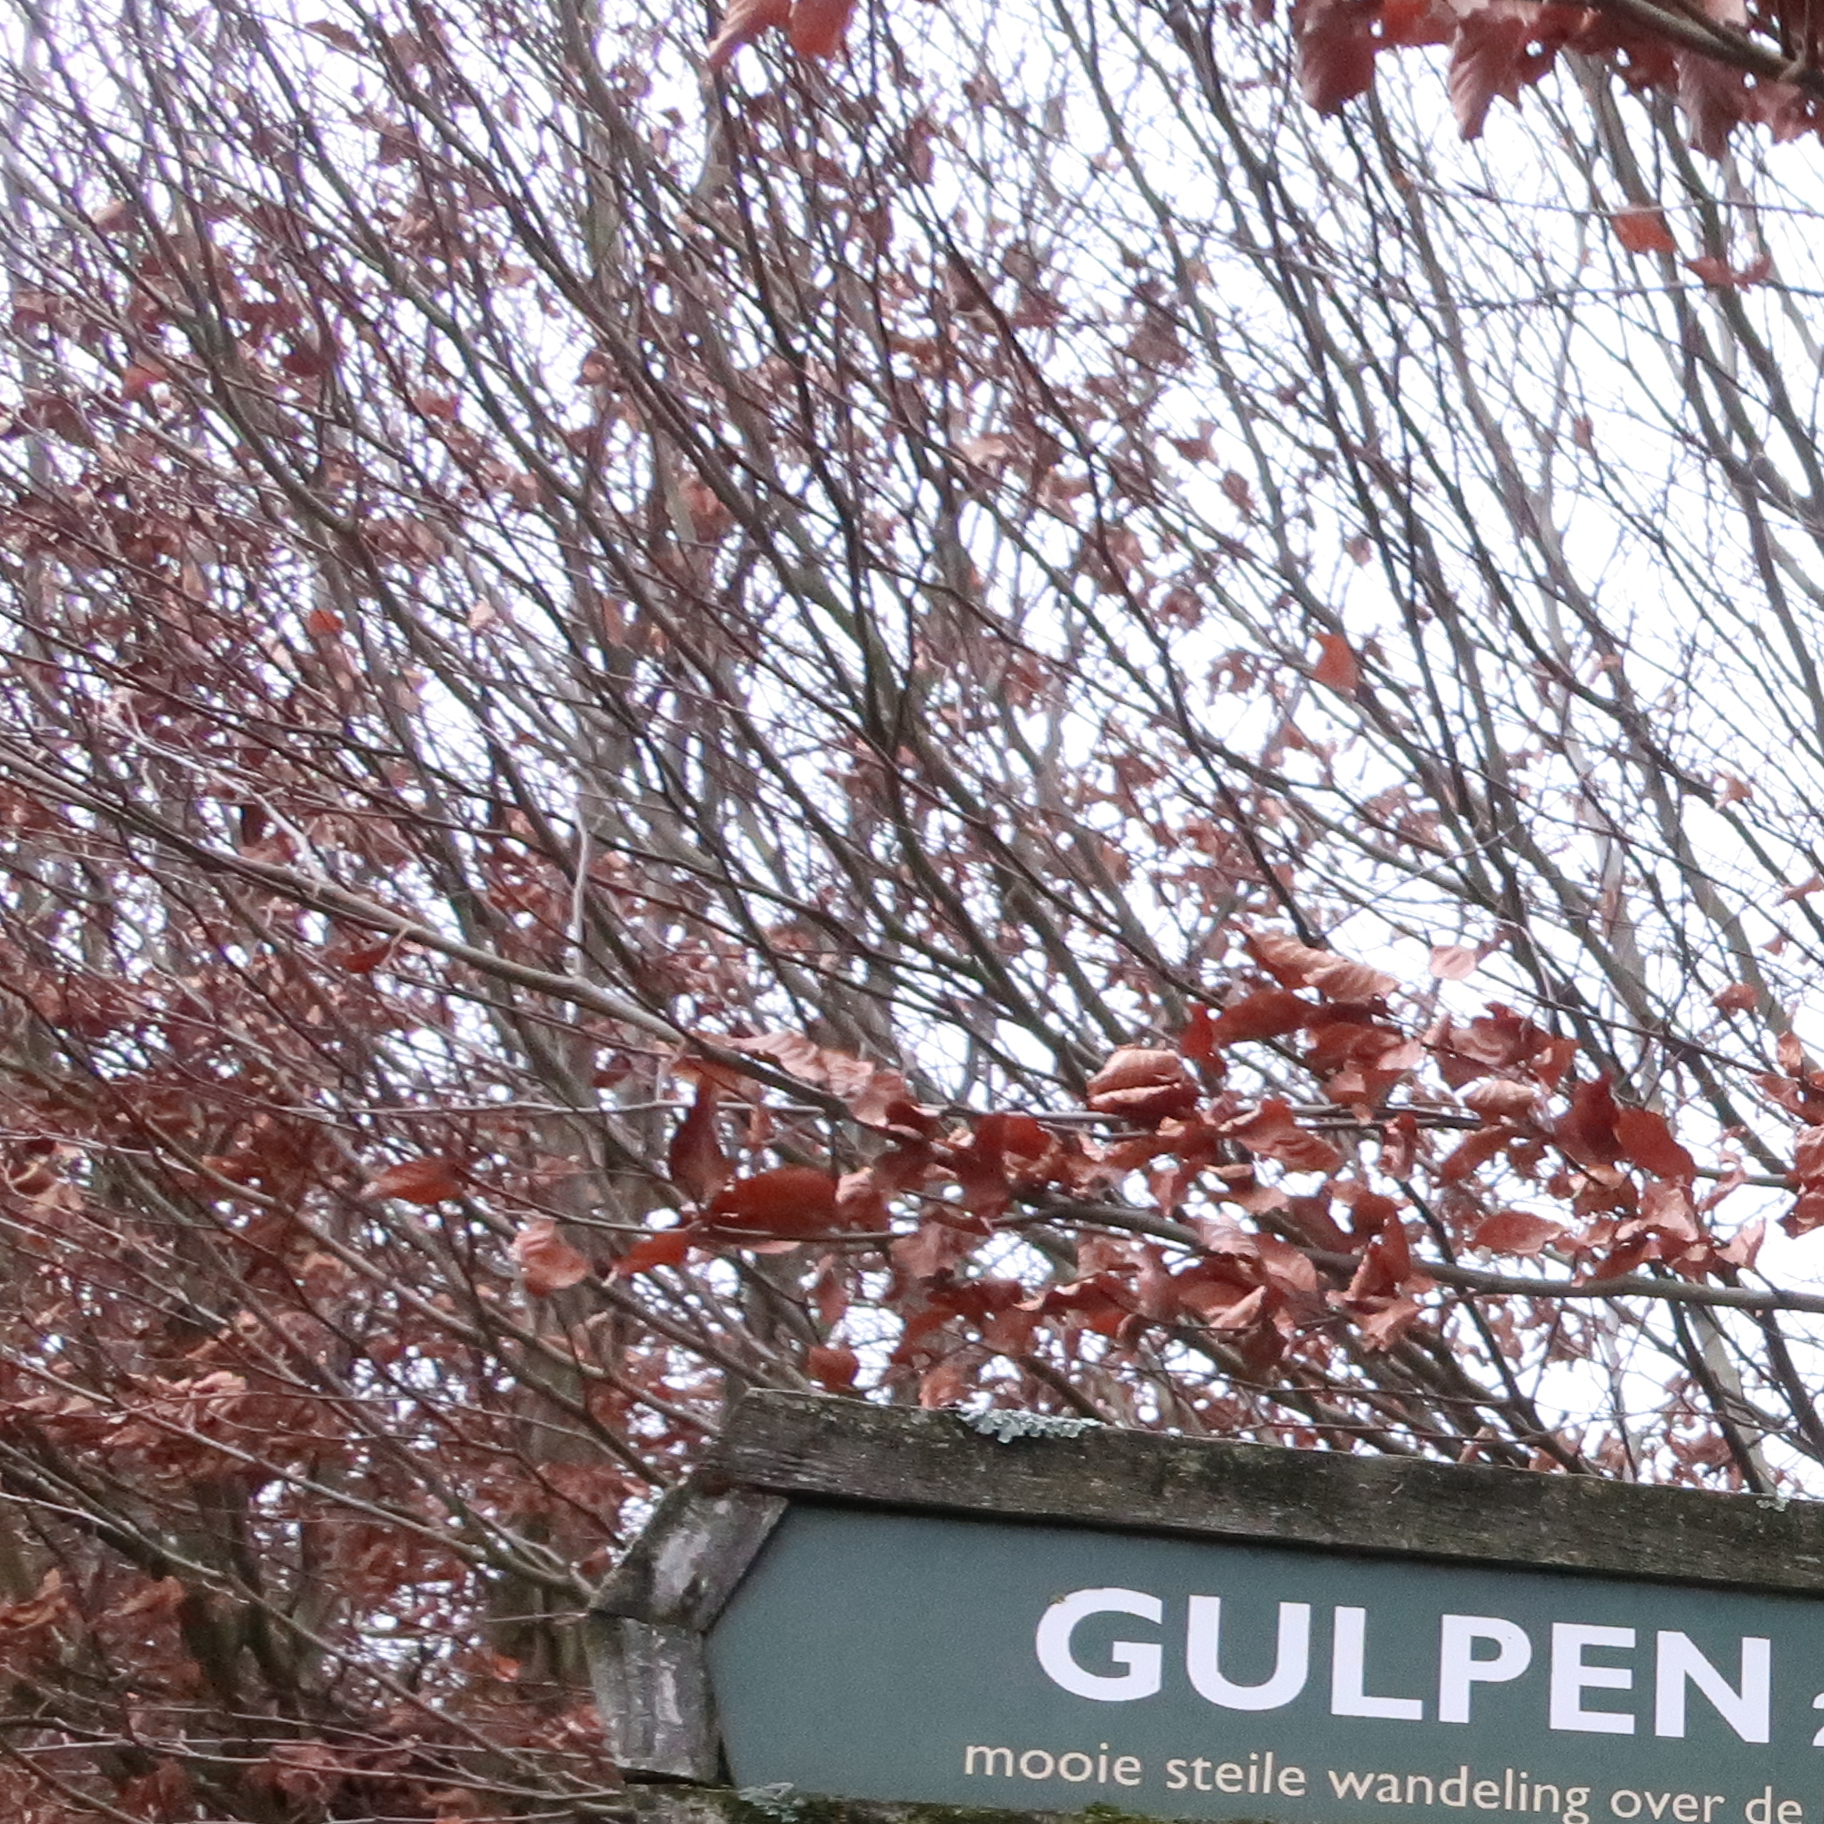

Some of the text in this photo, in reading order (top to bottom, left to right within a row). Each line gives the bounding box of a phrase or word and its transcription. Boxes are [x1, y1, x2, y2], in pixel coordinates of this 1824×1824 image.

[1035, 1587, 1771, 1750] GULPEN
[964, 1742, 1142, 1787] mooie
[1166, 1751, 1306, 1797] steile
[1610, 1789, 1726, 1823] over
